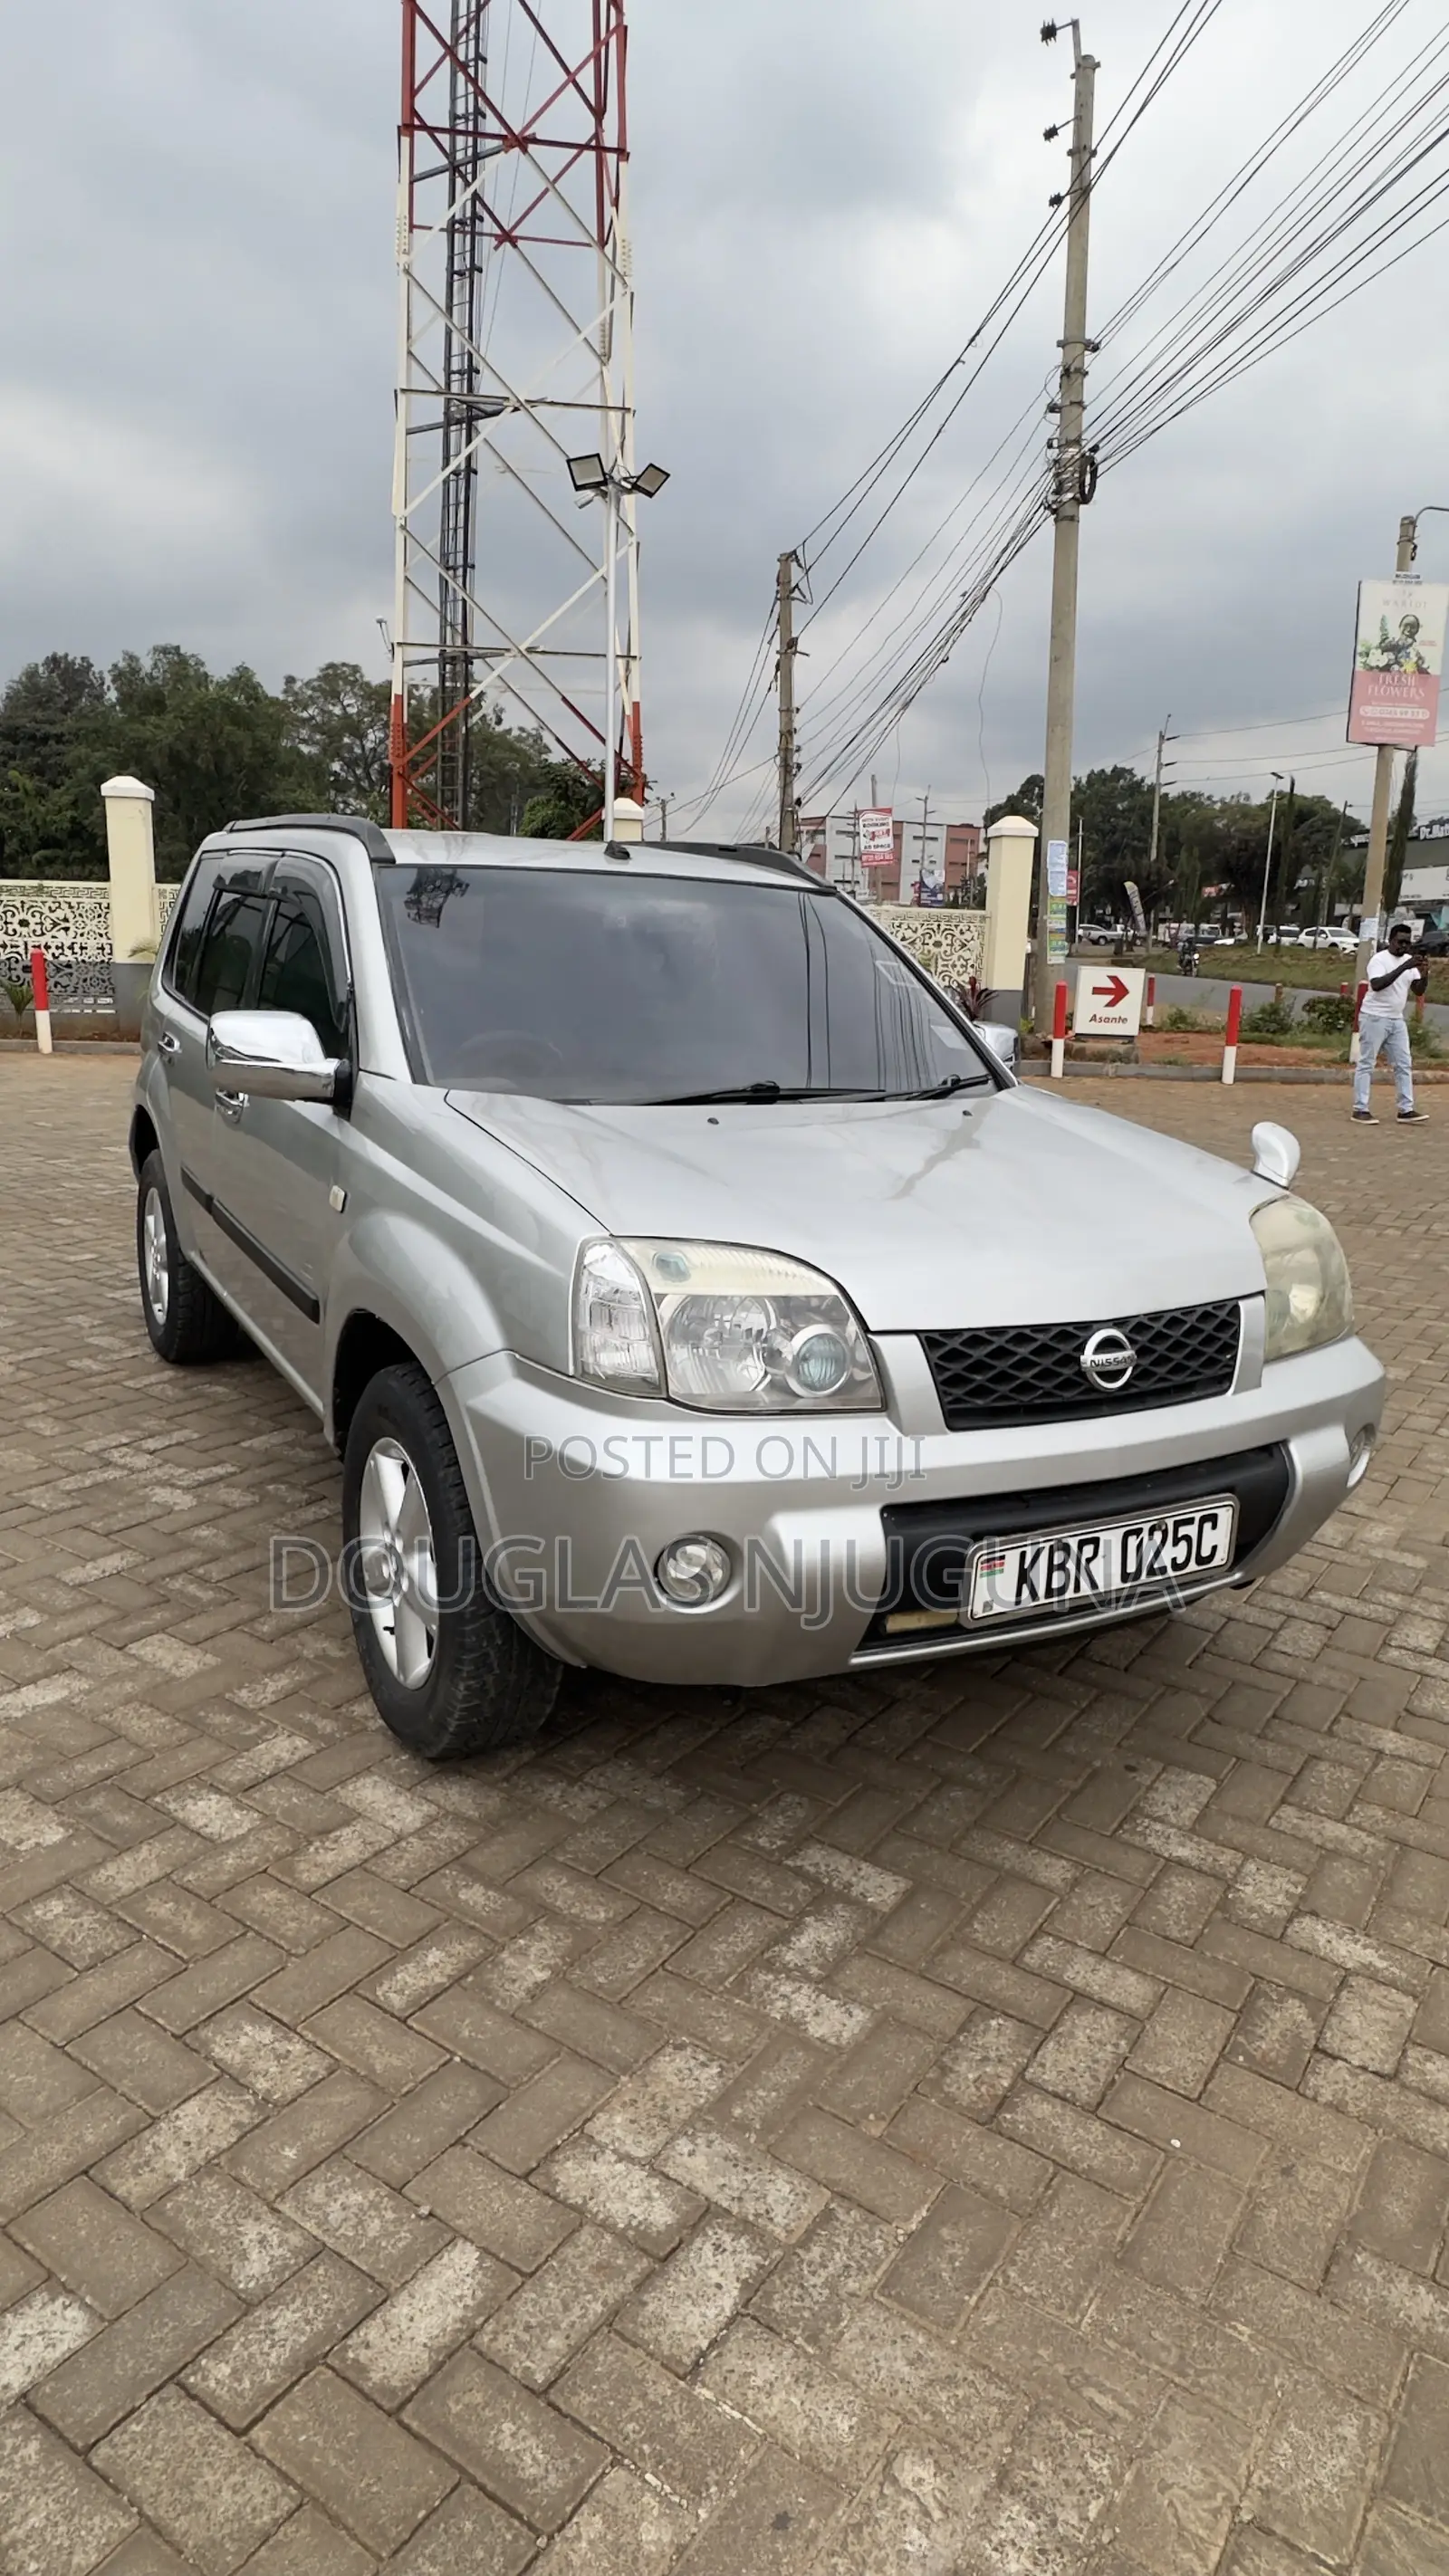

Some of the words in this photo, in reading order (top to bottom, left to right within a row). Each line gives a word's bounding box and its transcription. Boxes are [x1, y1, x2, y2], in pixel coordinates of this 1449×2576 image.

[1378, 673, 1416, 686] FRESH
[1367, 685, 1425, 700] FLOWERS
[1089, 1013, 1128, 1024] Asante
[1089, 1355, 1136, 1368] NISSAN
[1014, 1537, 1100, 1606] KBR
[1120, 1512, 1218, 1584] 025C
